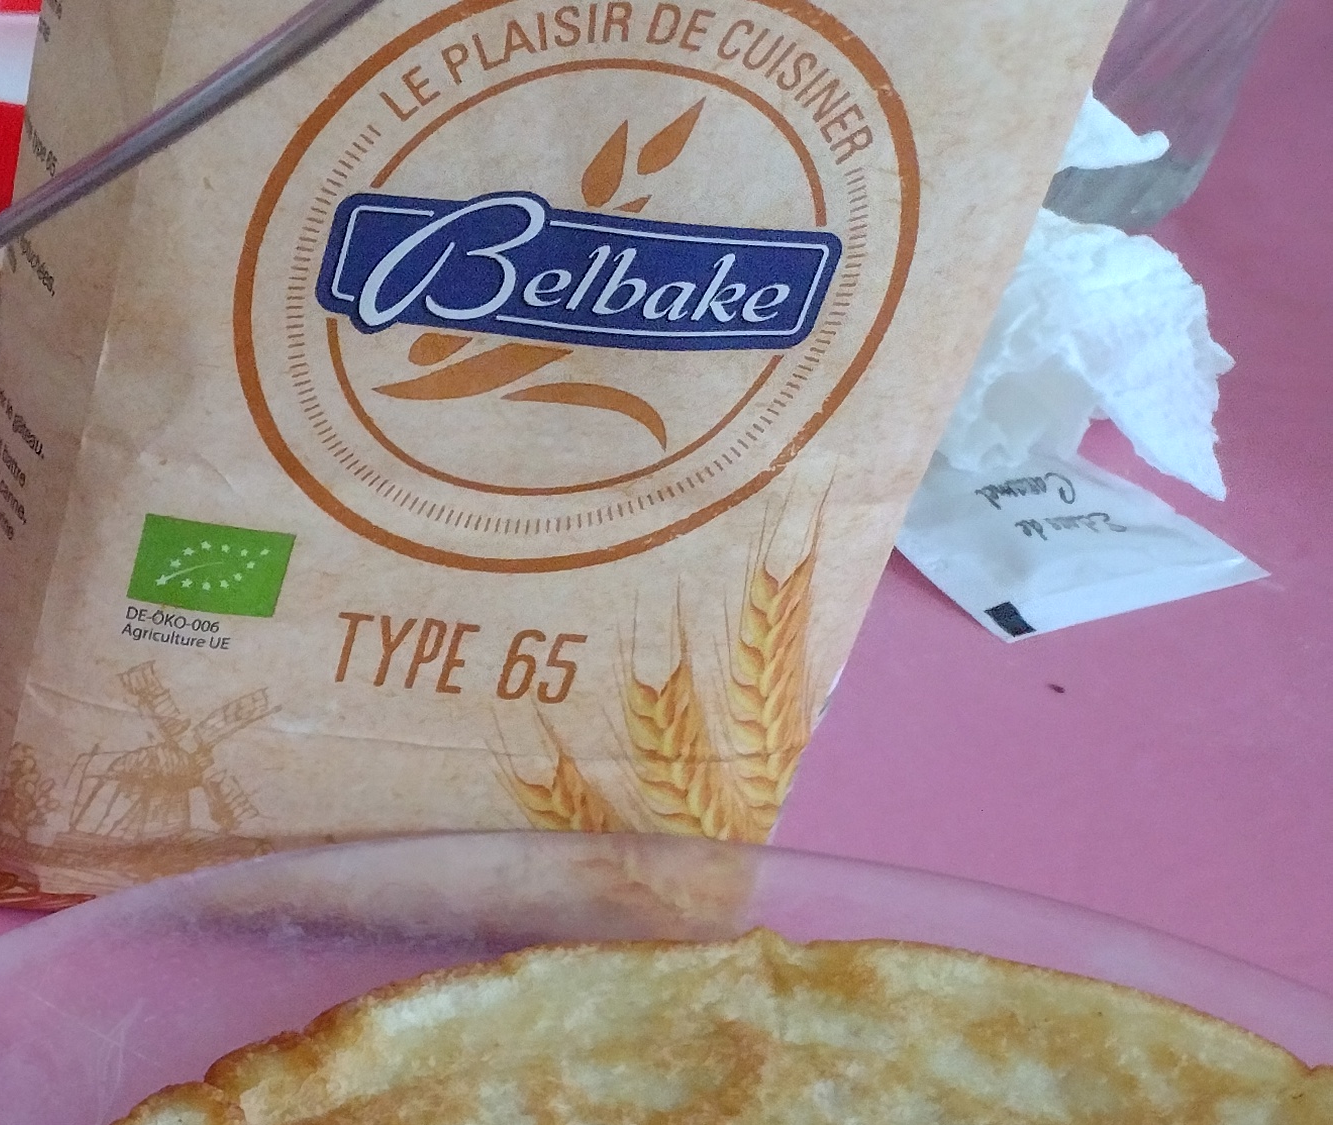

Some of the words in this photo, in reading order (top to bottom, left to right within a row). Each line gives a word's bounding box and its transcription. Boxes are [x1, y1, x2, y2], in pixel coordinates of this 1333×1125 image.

[379, 65, 441, 122] LE
[441, 2, 633, 84] PLAISIR
[646, 2, 717, 53] DE
[717, 19, 874, 166] CUISINER
[358, 196, 791, 327] Belbake
[121, 623, 206, 648] Agriculture
[209, 637, 231, 650] UE
[125, 606, 220, 633] DE-ÖKO-006
[334, 611, 481, 695] TYPE
[496, 629, 589, 705] 65
